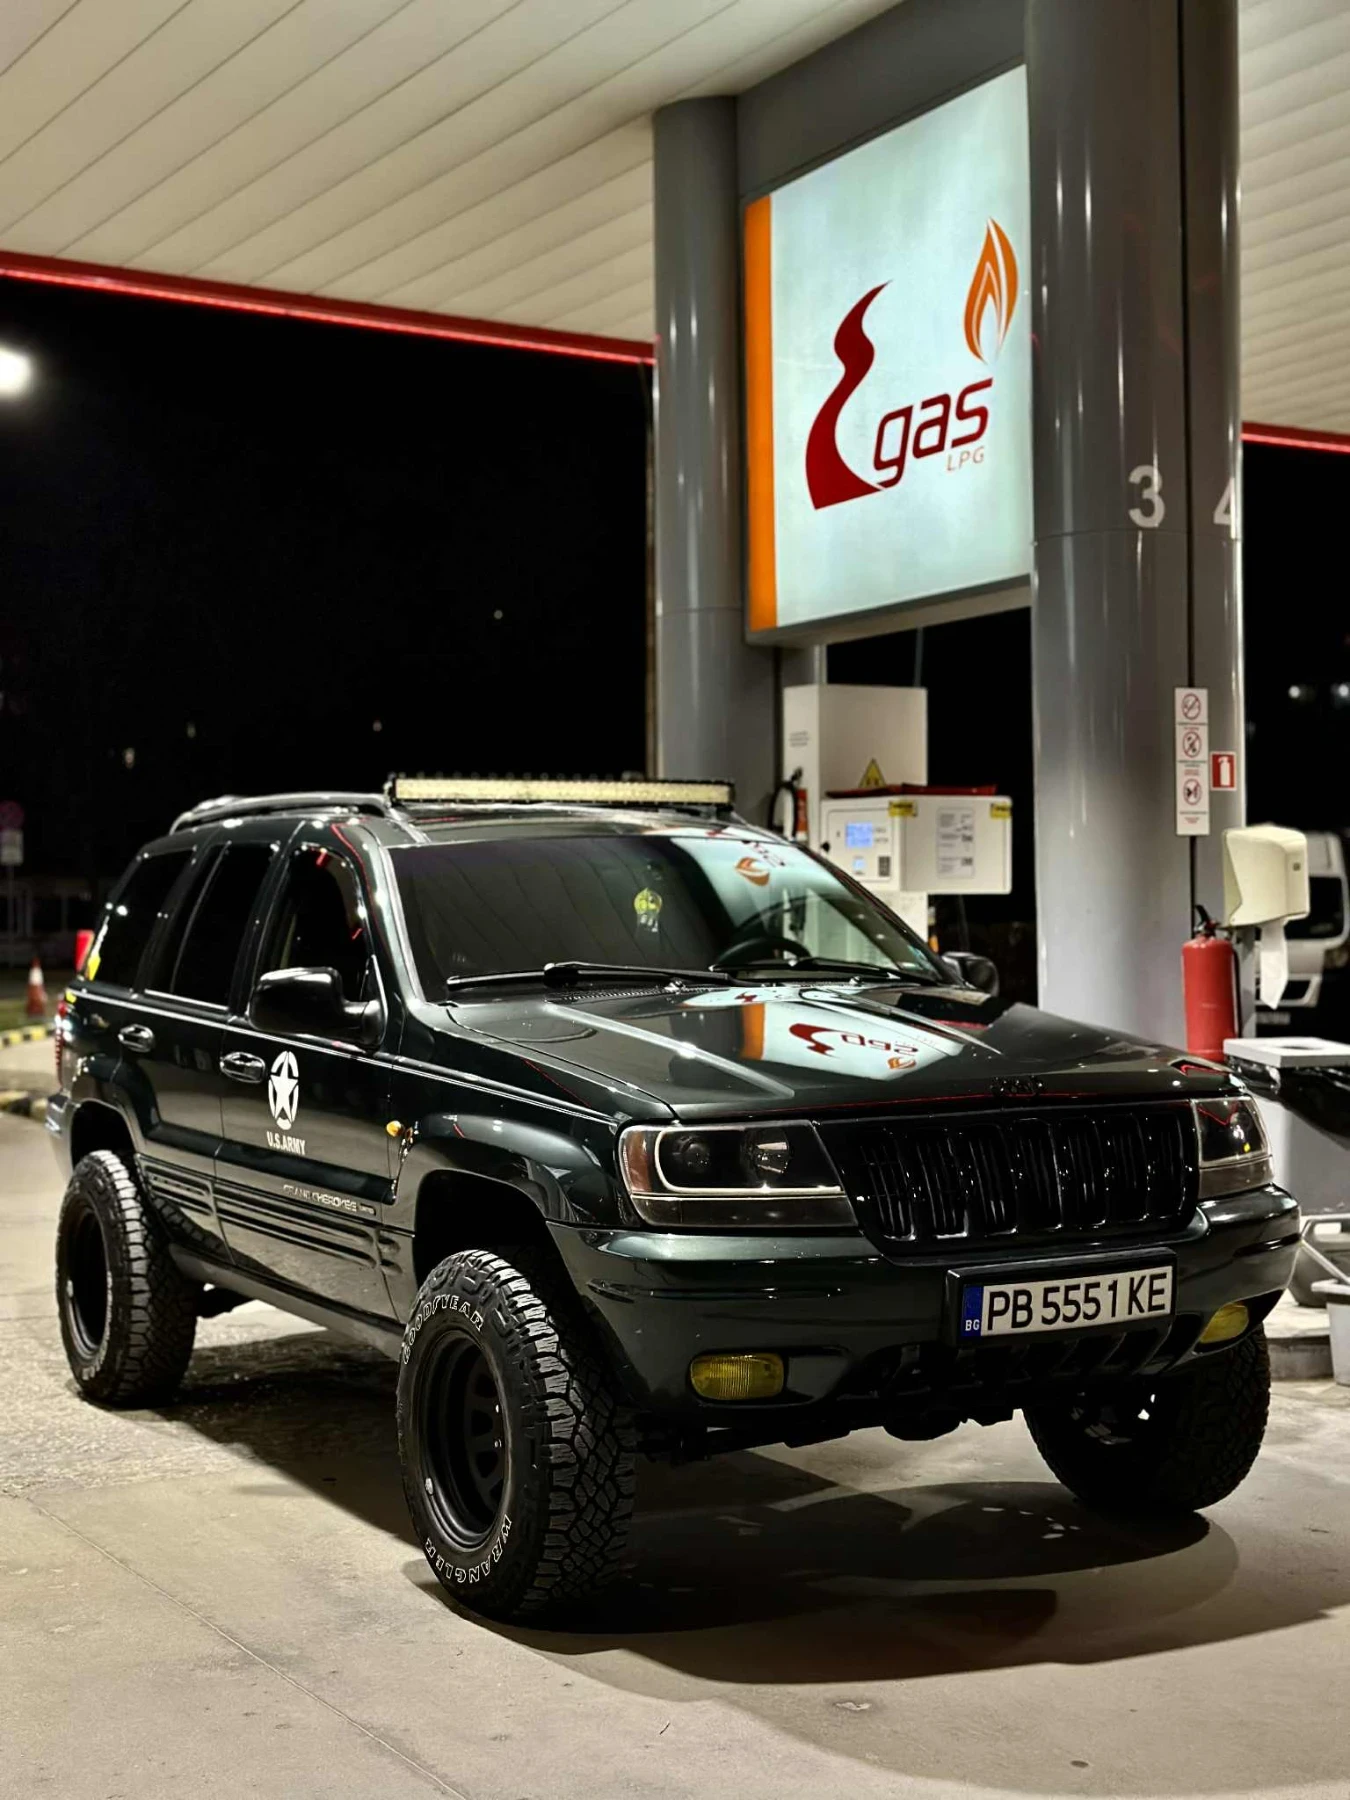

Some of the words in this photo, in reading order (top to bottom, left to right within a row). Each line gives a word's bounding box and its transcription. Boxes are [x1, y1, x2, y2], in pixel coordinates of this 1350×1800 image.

[873, 377, 993, 488] gas
[946, 446, 985, 472] LPG
[1128, 464, 1166, 528] 3
[1213, 476, 1238, 539] 4
[964, 1319, 981, 1332] BG
[986, 1289, 1034, 1331] PB
[1040, 1279, 1119, 1326] 5551
[1127, 1272, 1168, 1316] KE
[424, 1513, 512, 1584] WRANGLER
